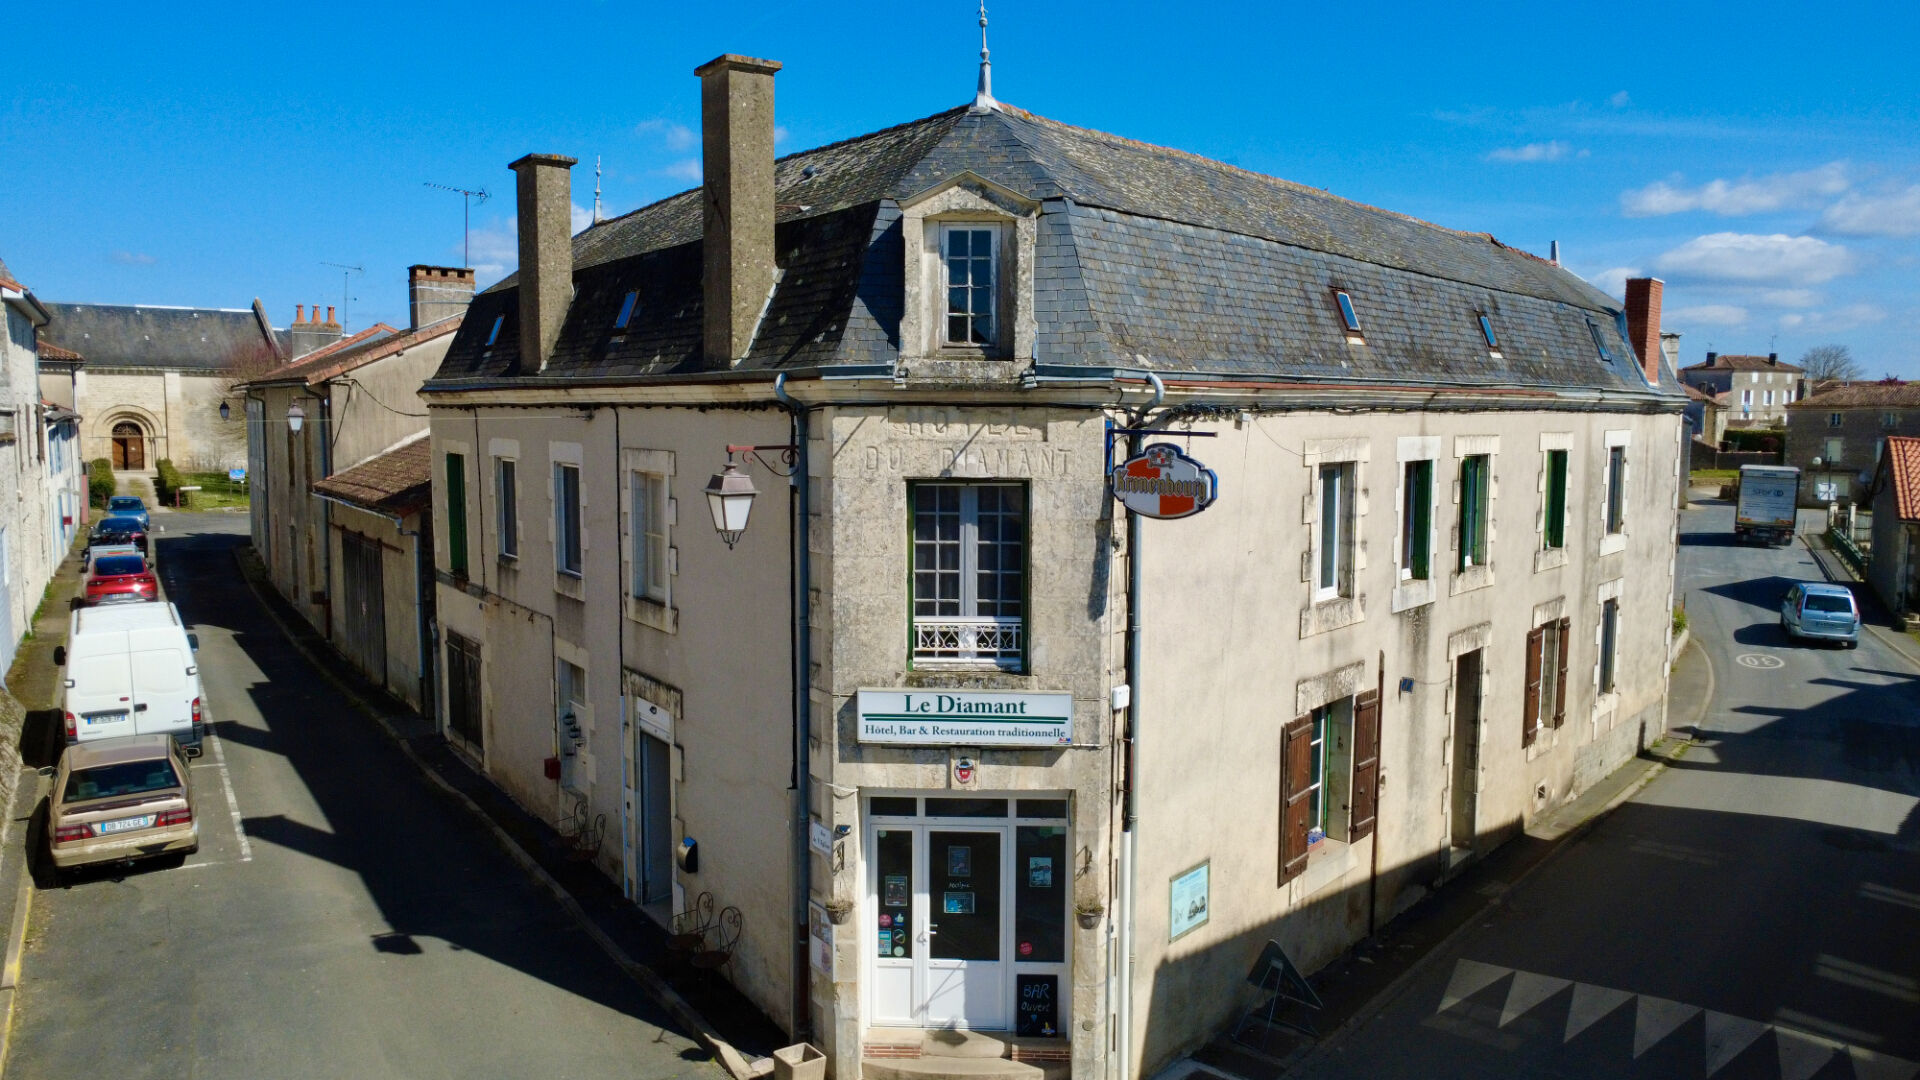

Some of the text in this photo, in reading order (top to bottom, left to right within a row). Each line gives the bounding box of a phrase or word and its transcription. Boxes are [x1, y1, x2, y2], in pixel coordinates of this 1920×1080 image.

[866, 446, 903, 471] DU
[1115, 469, 1207, 503] Kronenbourg
[904, 694, 1027, 714] Le Diamant
[899, 725, 917, 735] Bar
[918, 725, 928, 735] &
[932, 725, 996, 737] Restauration
[997, 727, 1066, 738] traditionnelle
[1023, 983, 1050, 1000] BAR
